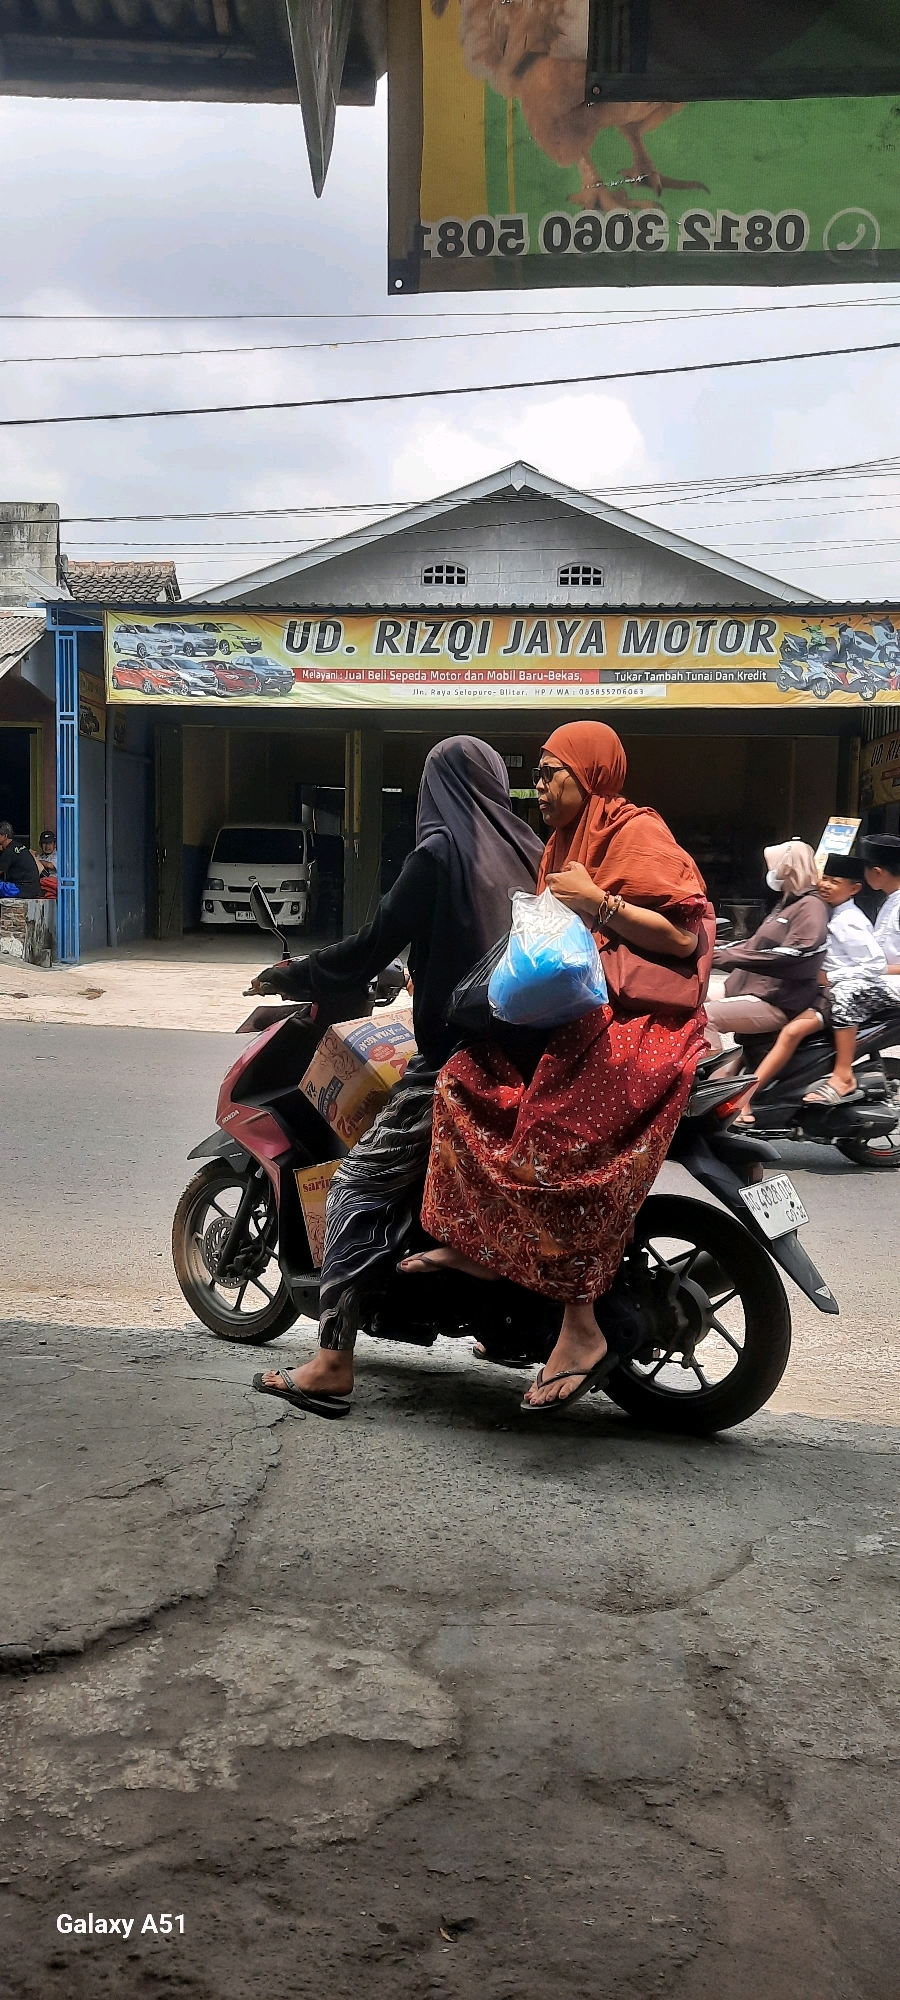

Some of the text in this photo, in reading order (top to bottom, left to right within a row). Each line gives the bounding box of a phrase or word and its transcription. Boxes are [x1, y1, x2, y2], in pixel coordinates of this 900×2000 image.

[284, 619, 777, 661] UD. RIZQI JAYA MOTOR
[344, 670, 365, 680] Jual
[368, 670, 387, 680] Beli
[389, 670, 427, 683] Sepeda
[430, 670, 462, 680] Motor
[464, 670, 484, 681] dan
[487, 670, 516, 680] Mobil
[519, 670, 583, 682] Baru-Bekas,
[614, 671, 643, 682] Tukar
[644, 671, 683, 681] Tambah
[685, 671, 713, 681] Tunai
[715, 671, 735, 681] Dan
[737, 670, 767, 680] Kredit
[756, 1184, 783, 1208] 4828
